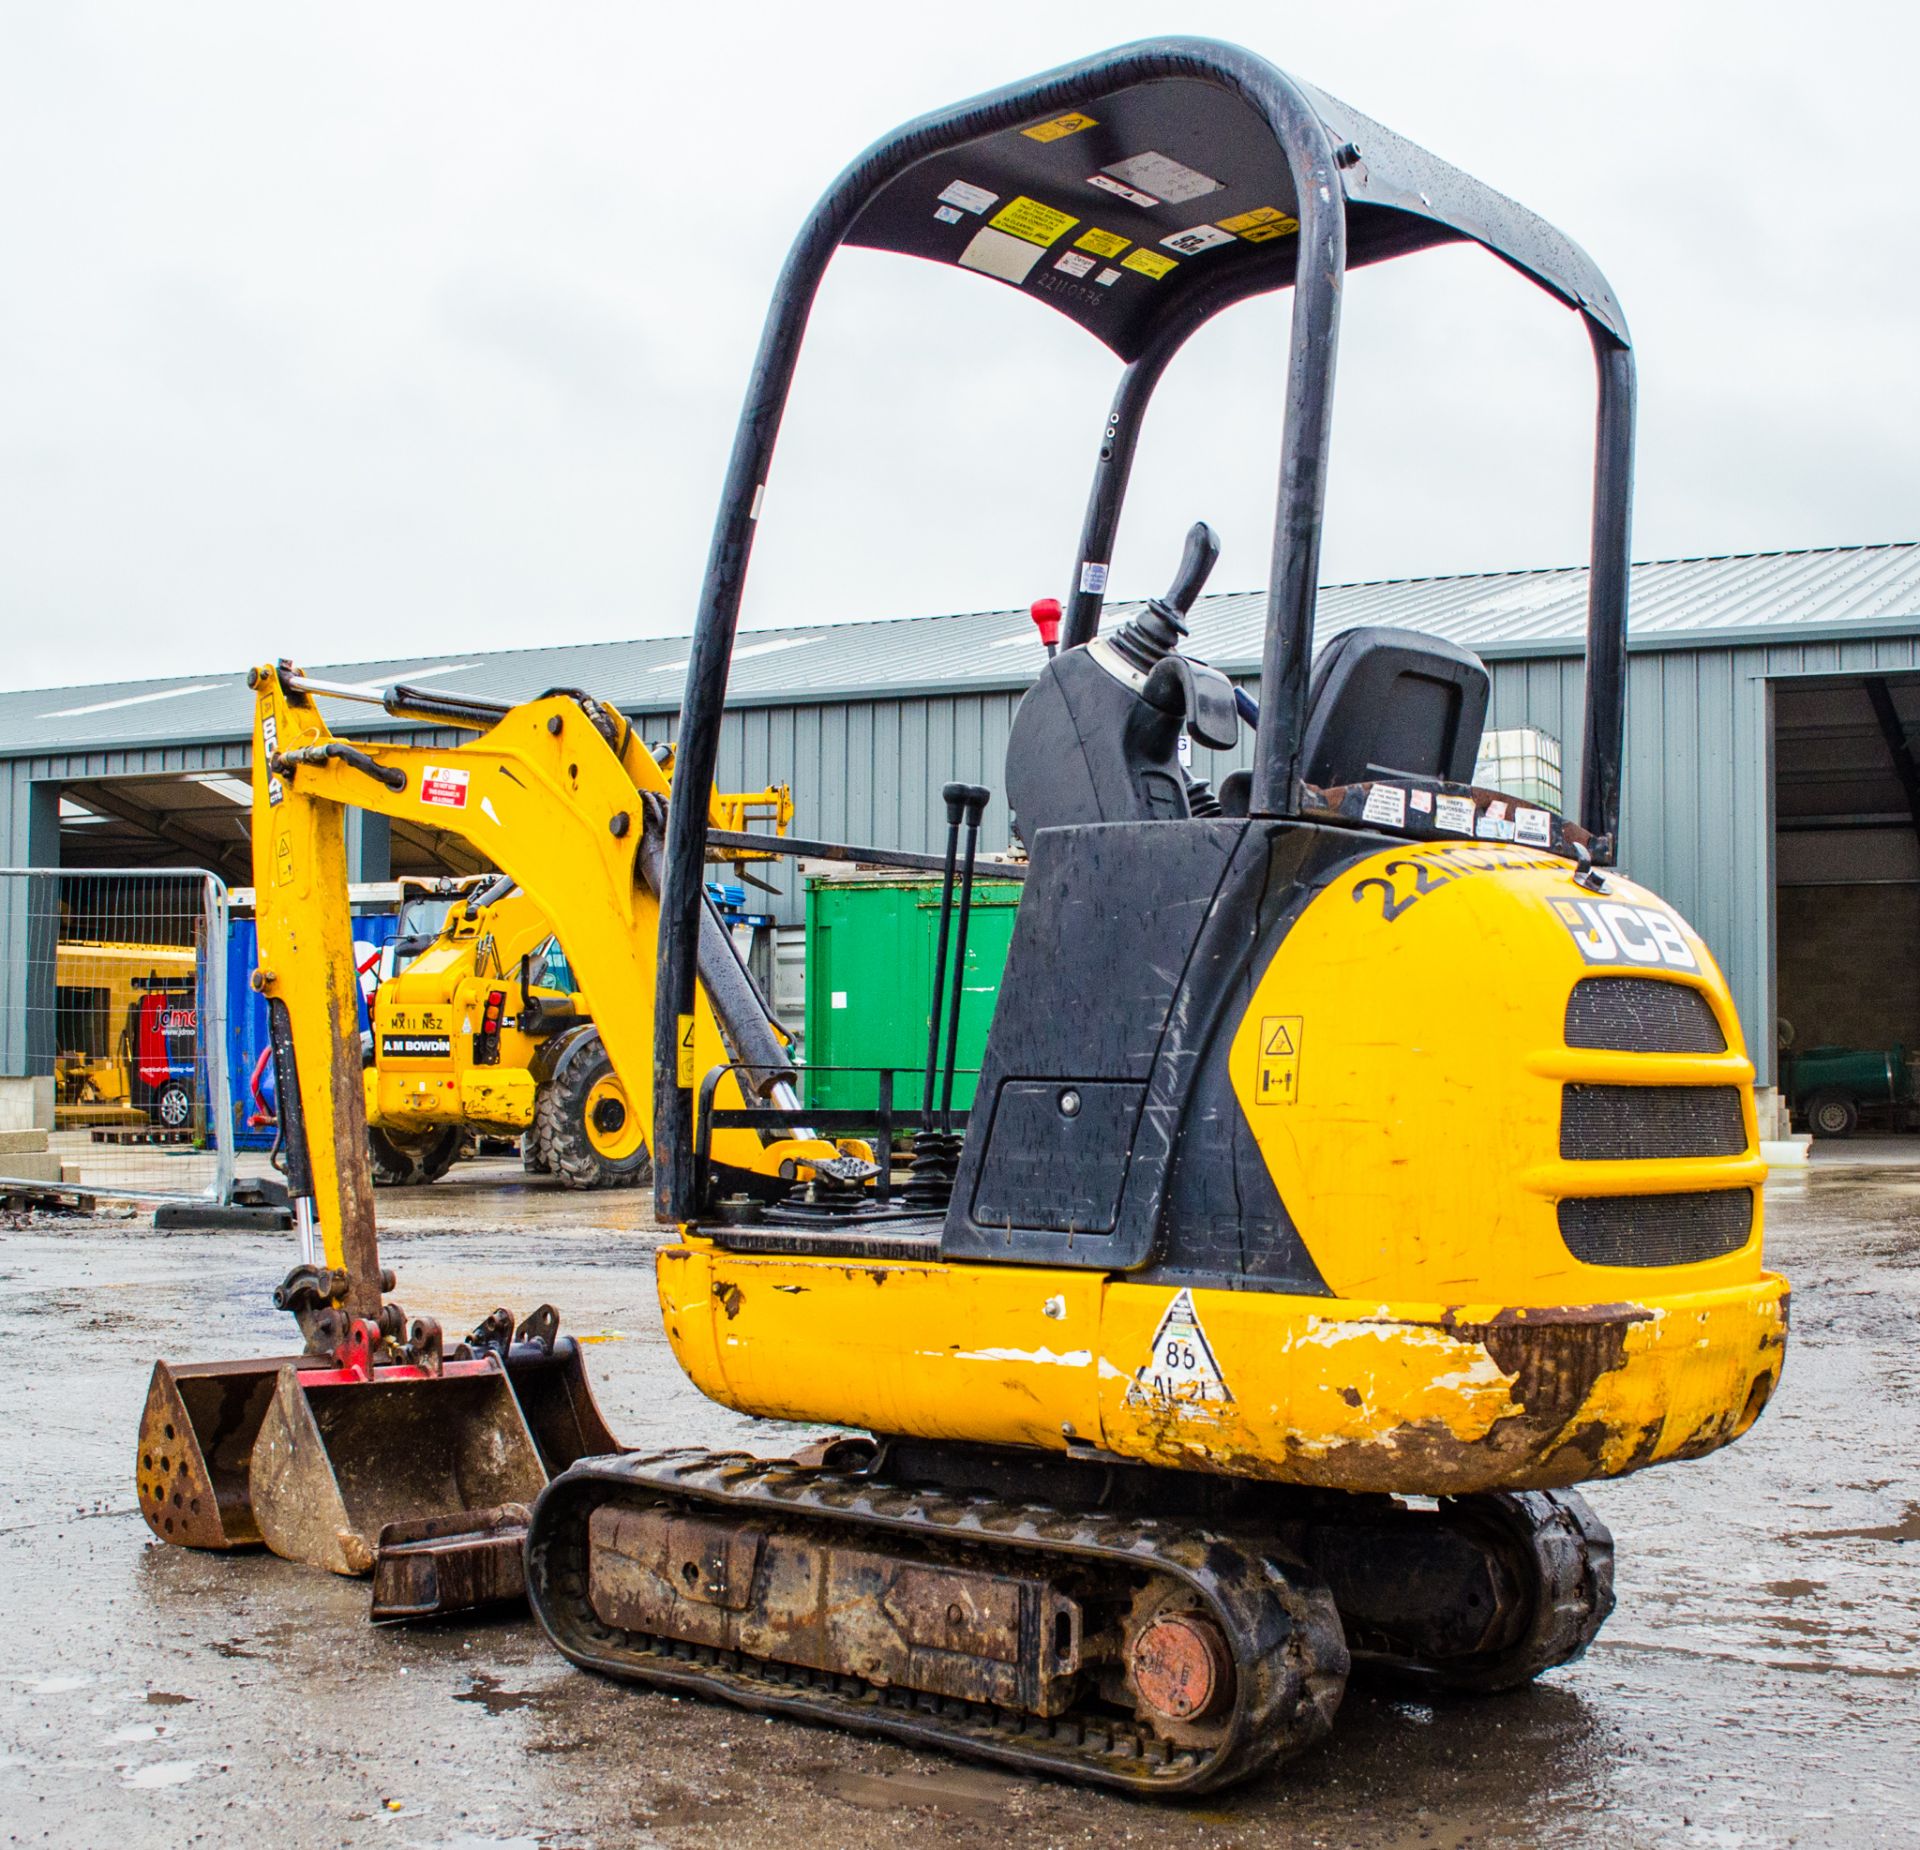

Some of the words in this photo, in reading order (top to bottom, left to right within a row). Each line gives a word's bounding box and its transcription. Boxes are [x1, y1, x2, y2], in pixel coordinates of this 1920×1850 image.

[262, 717, 282, 794] 804
[1573, 902, 1697, 967] JCB
[391, 1019, 416, 1029] MX11
[422, 1019, 443, 1029] NSZ
[1166, 1341, 1196, 1370] 86
